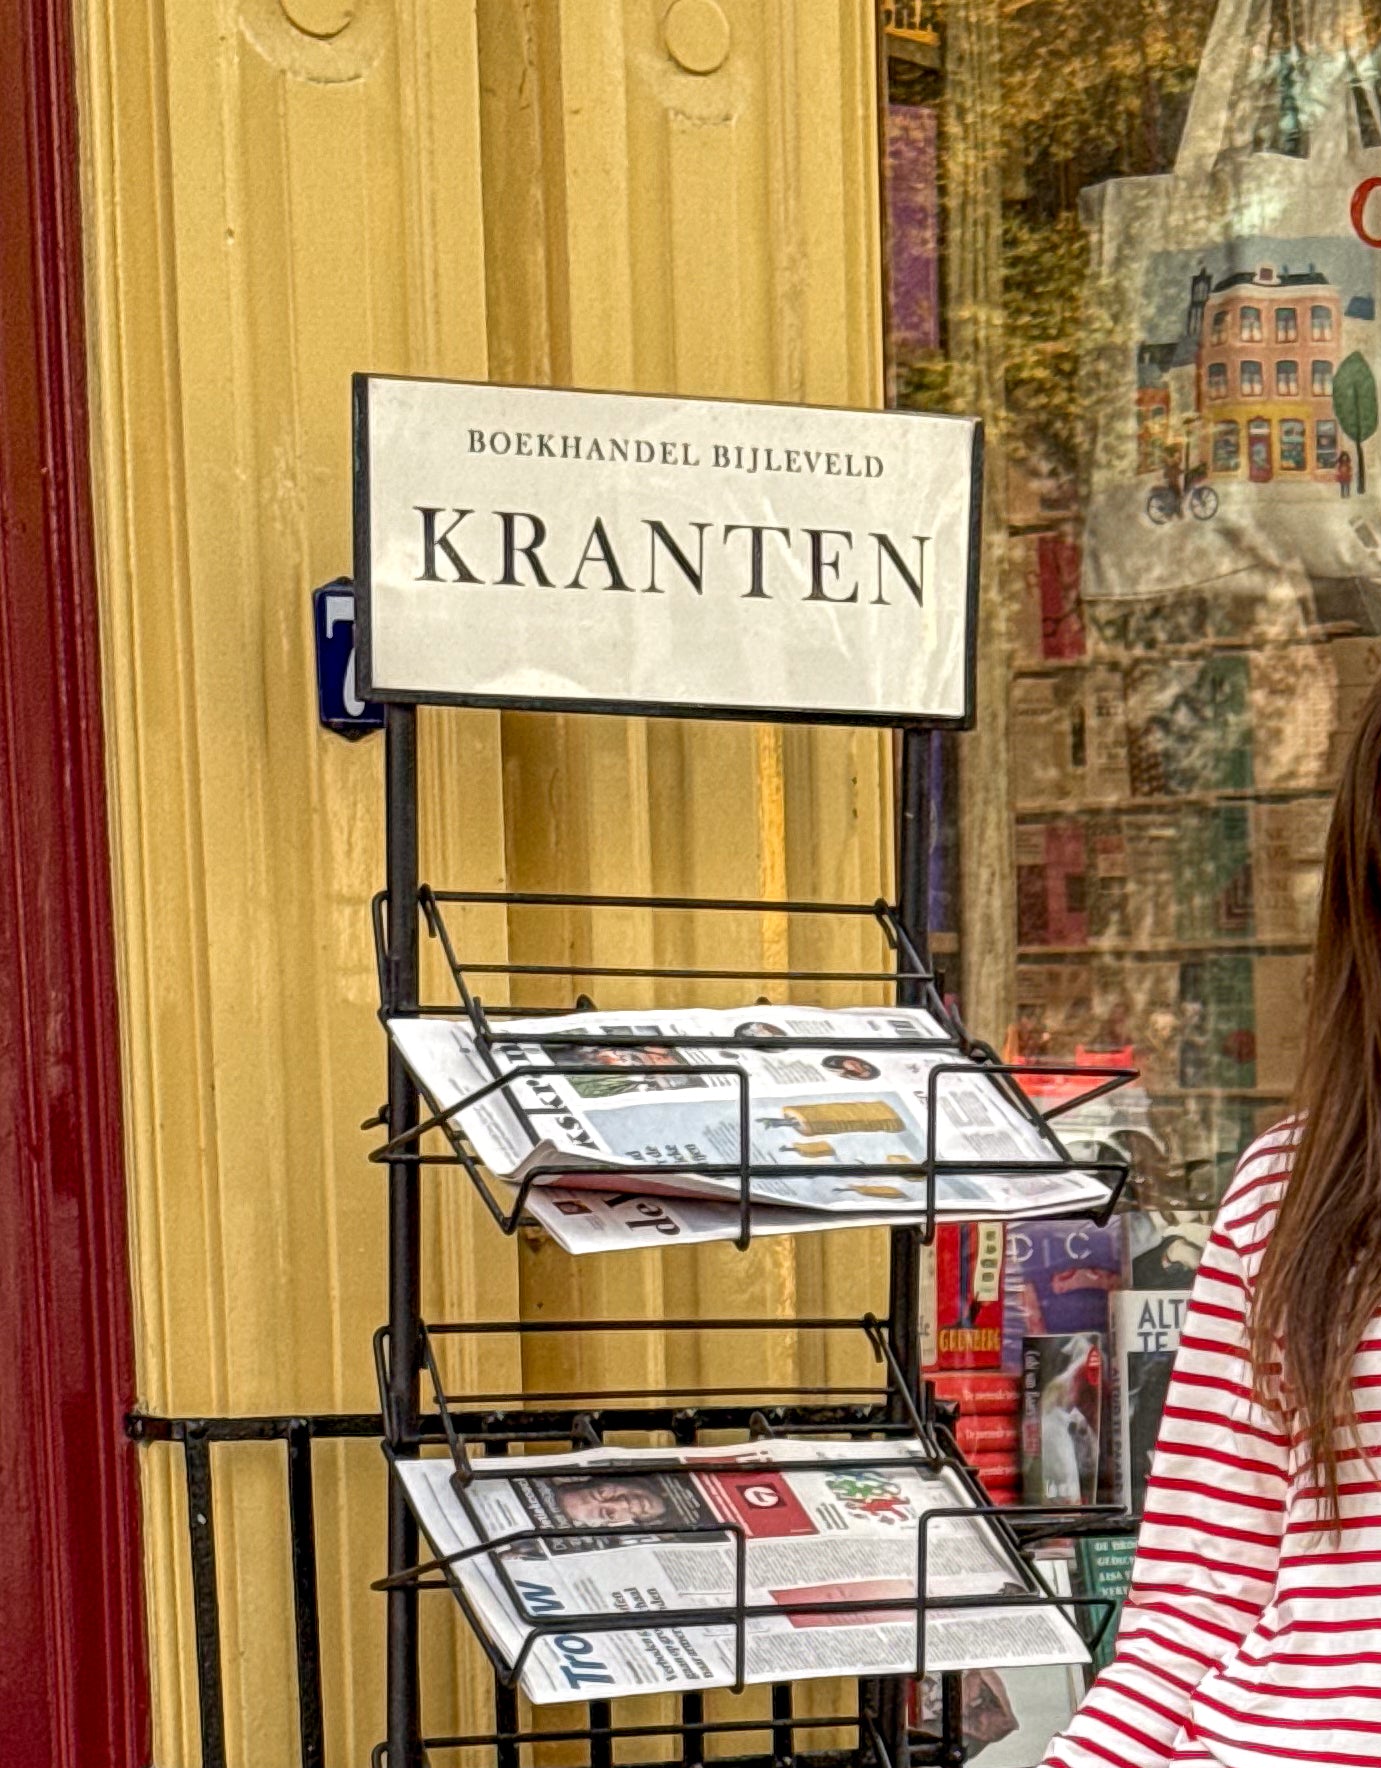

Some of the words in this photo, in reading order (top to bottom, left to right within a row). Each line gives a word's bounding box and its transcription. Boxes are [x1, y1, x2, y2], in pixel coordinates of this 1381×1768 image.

[466, 429, 700, 467] BOEKHANDEL
[711, 445, 885, 479] BIJLEVELD
[412, 505, 932, 608] KRANTEN
[624, 1202, 681, 1236] de
[515, 1580, 616, 1690] Trow
